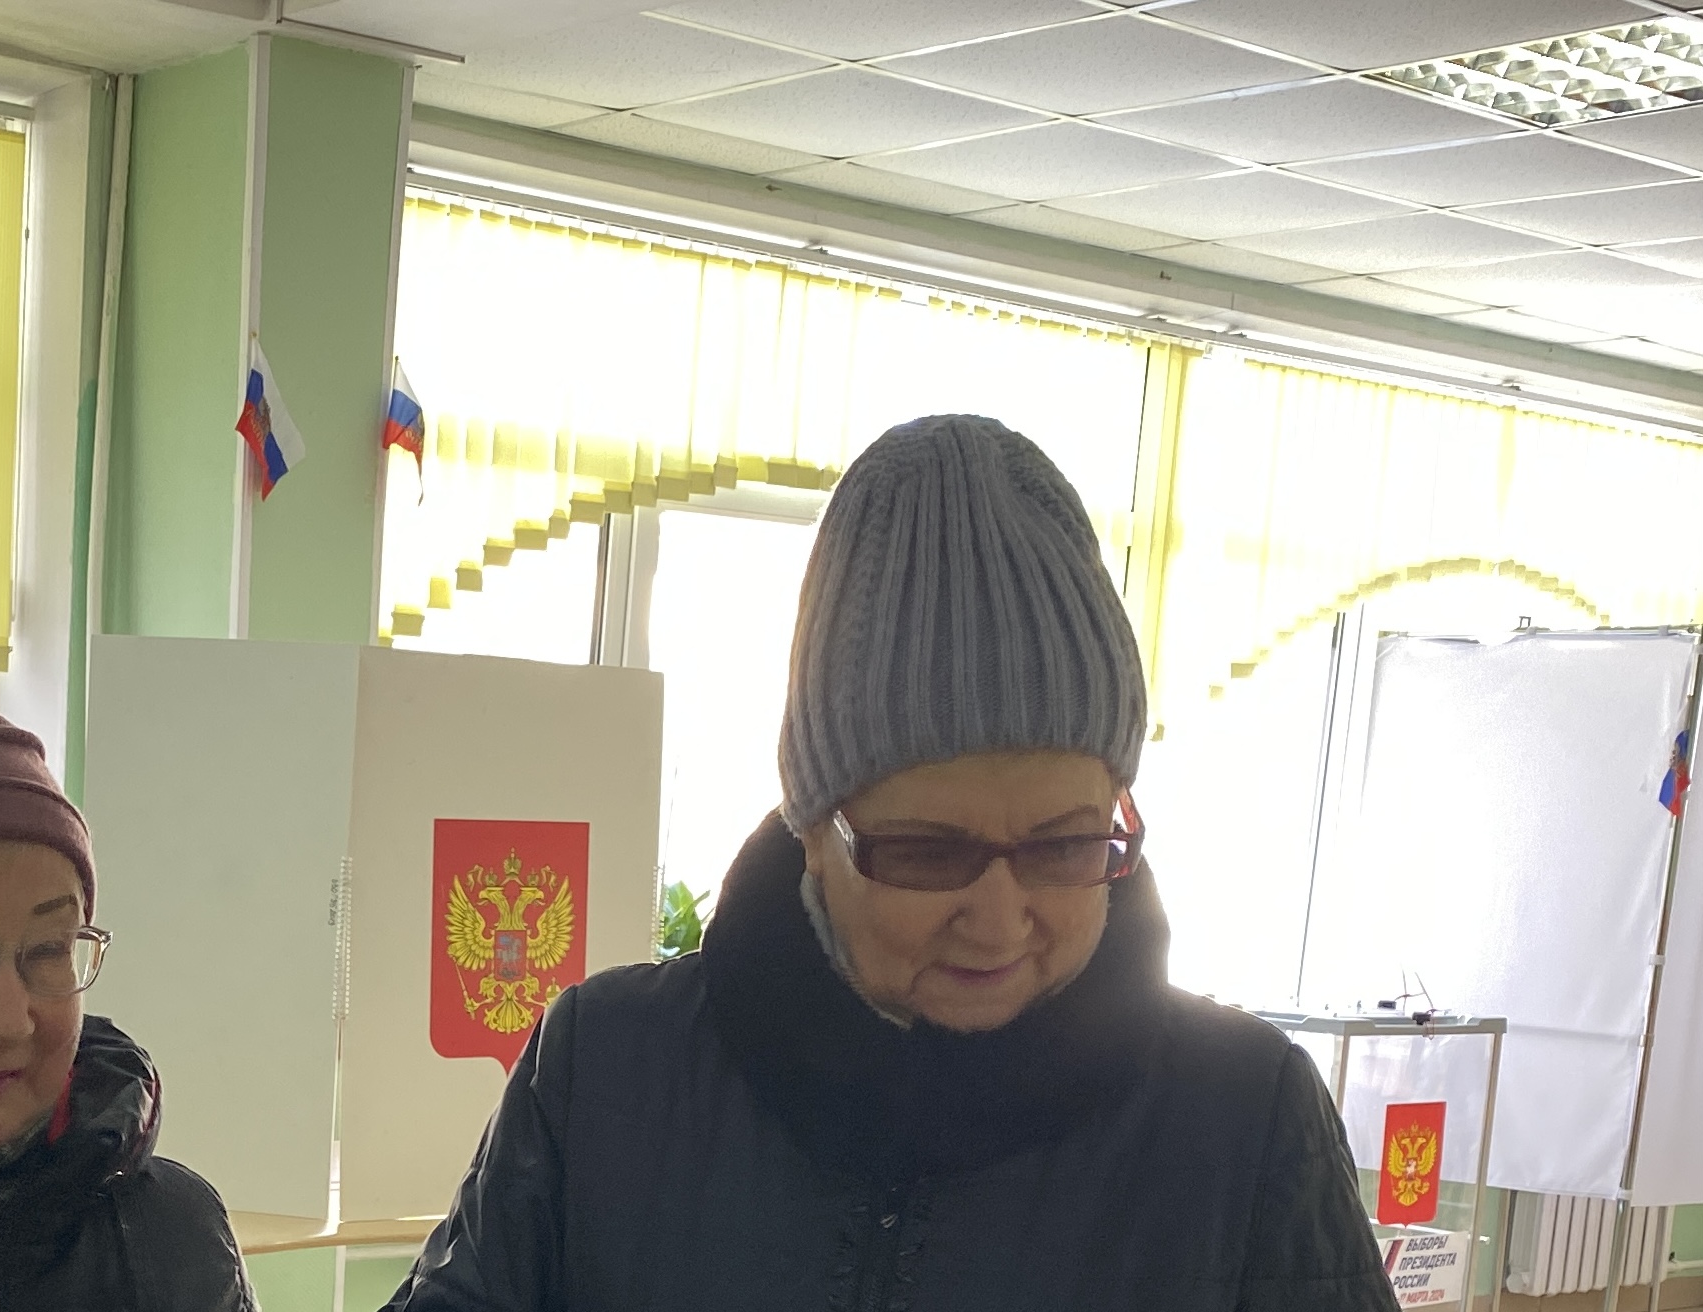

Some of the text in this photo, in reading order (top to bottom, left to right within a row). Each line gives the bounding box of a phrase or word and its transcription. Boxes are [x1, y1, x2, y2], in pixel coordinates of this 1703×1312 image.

[1405, 1235, 1449, 1252] ВЫБОРЫ
[1398, 1252, 1457, 1271] ПРЕЗИДЕНТА
[1393, 1273, 1431, 1289] РОССИИ
